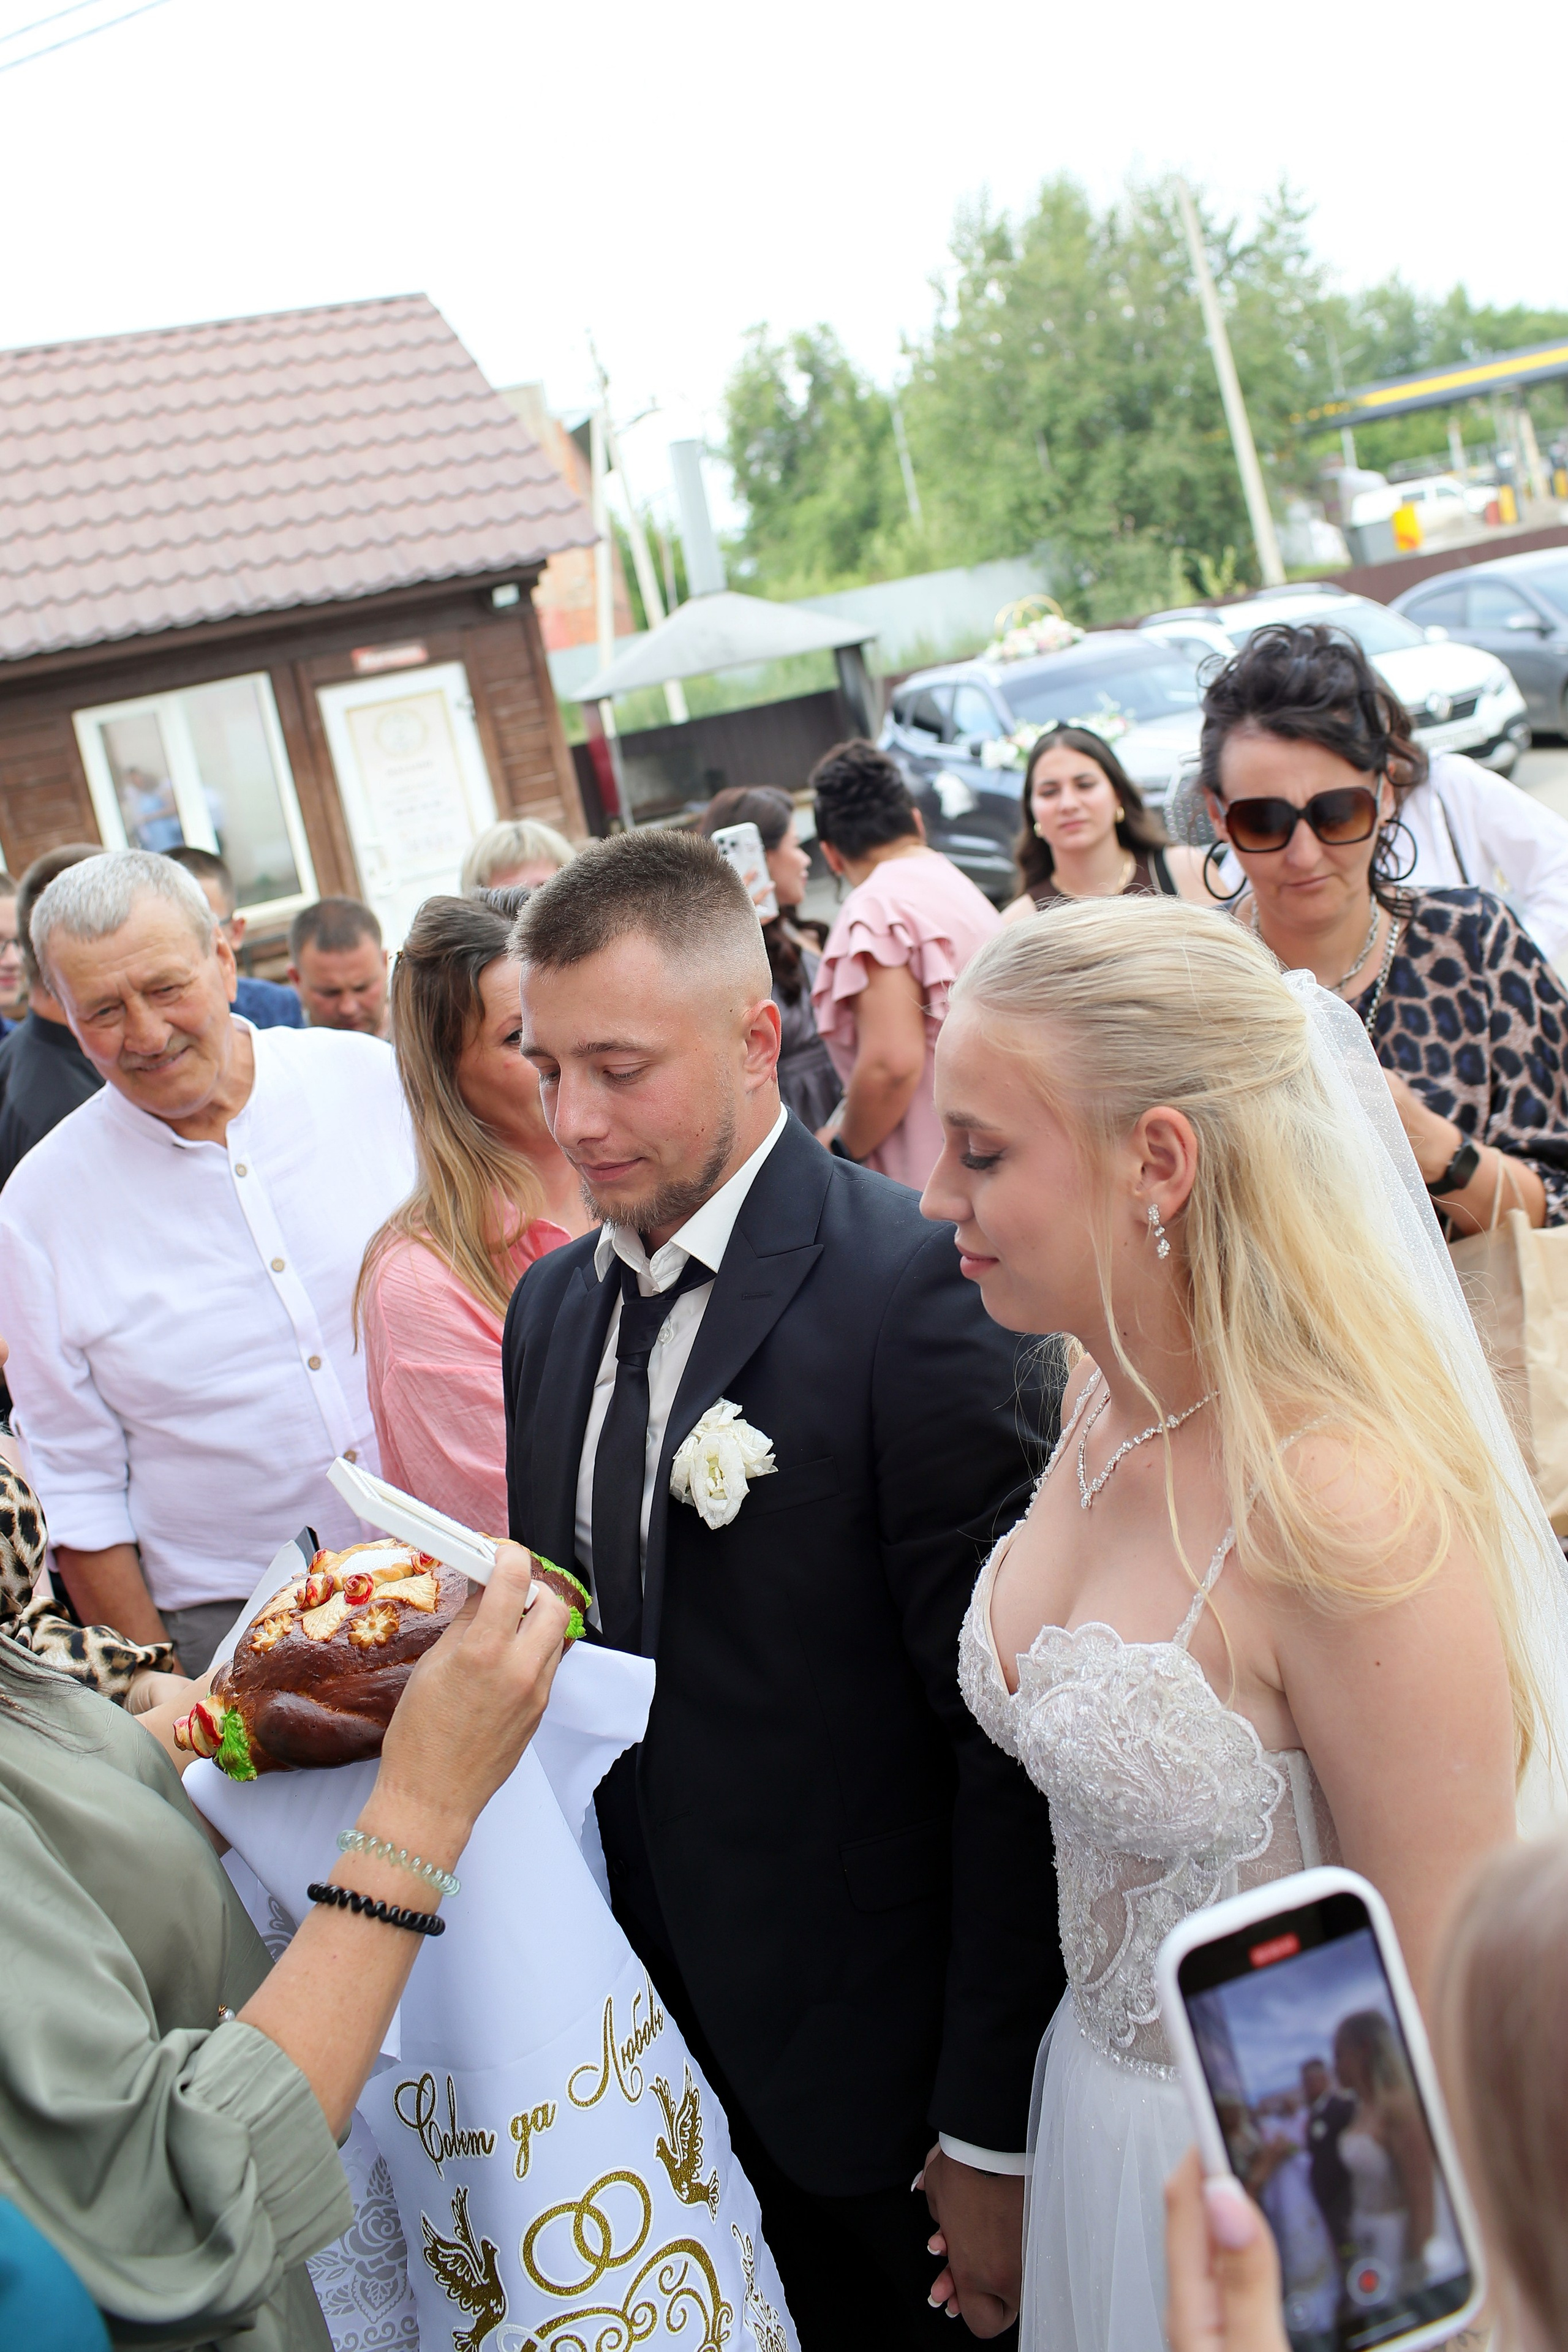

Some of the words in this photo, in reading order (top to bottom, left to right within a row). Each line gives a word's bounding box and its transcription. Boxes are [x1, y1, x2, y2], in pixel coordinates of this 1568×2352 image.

[393, 2071, 496, 2178] Совет
[510, 2101, 557, 2179] да
[568, 1964, 663, 2108] Любовь
